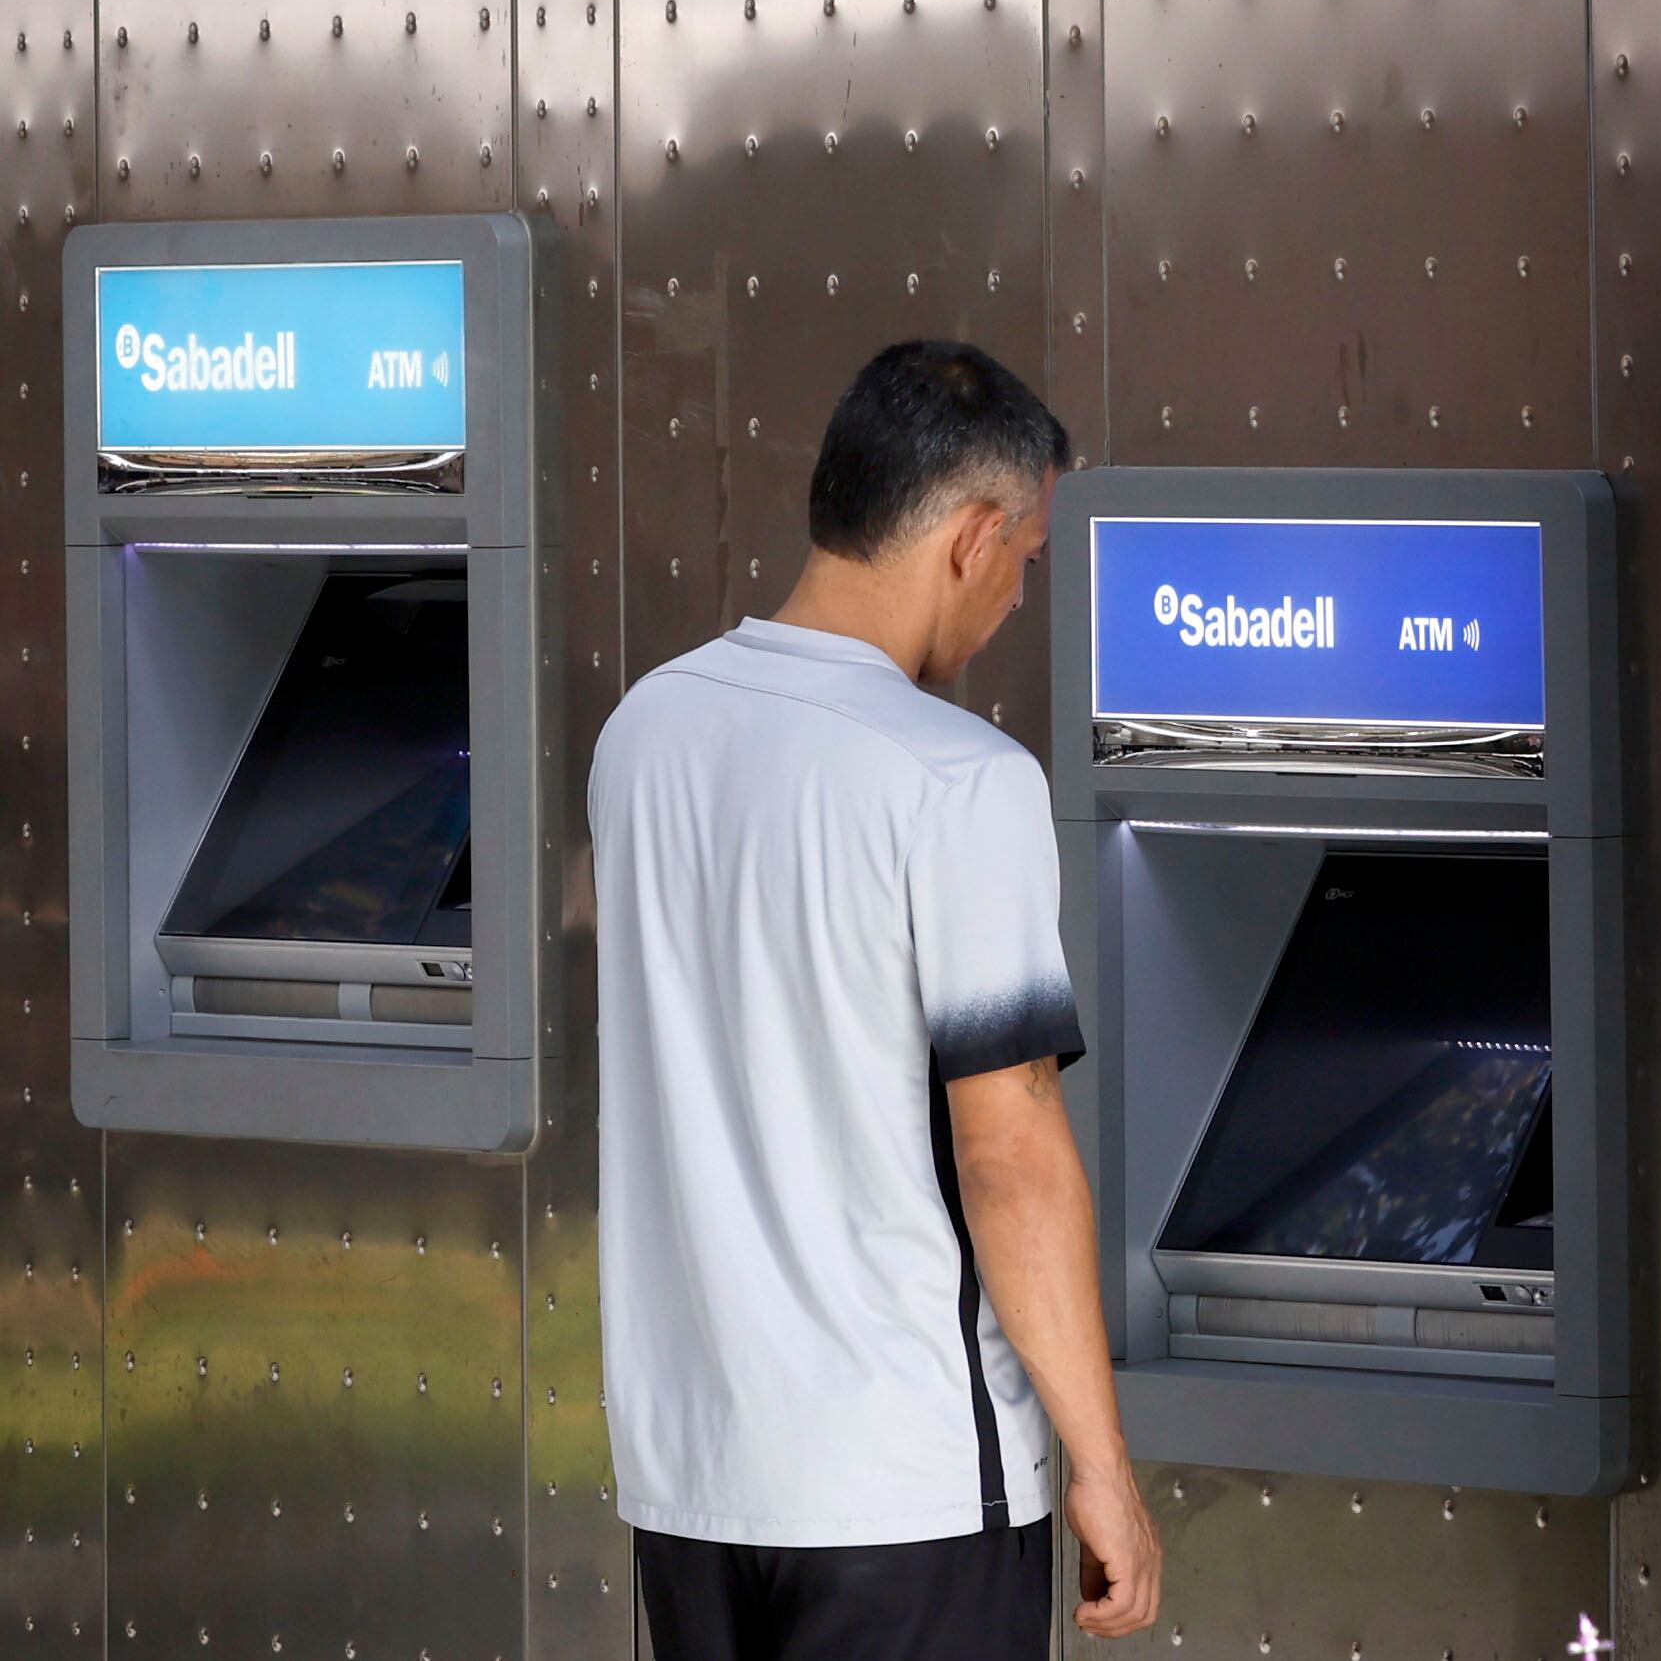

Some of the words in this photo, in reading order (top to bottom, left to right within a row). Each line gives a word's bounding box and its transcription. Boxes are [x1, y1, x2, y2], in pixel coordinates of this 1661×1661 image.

[141, 333, 296, 392] Sabadell
[368, 351, 423, 389] ATM
[1179, 596, 1336, 649] Sabadell
[1398, 617, 1454, 652] ATM
